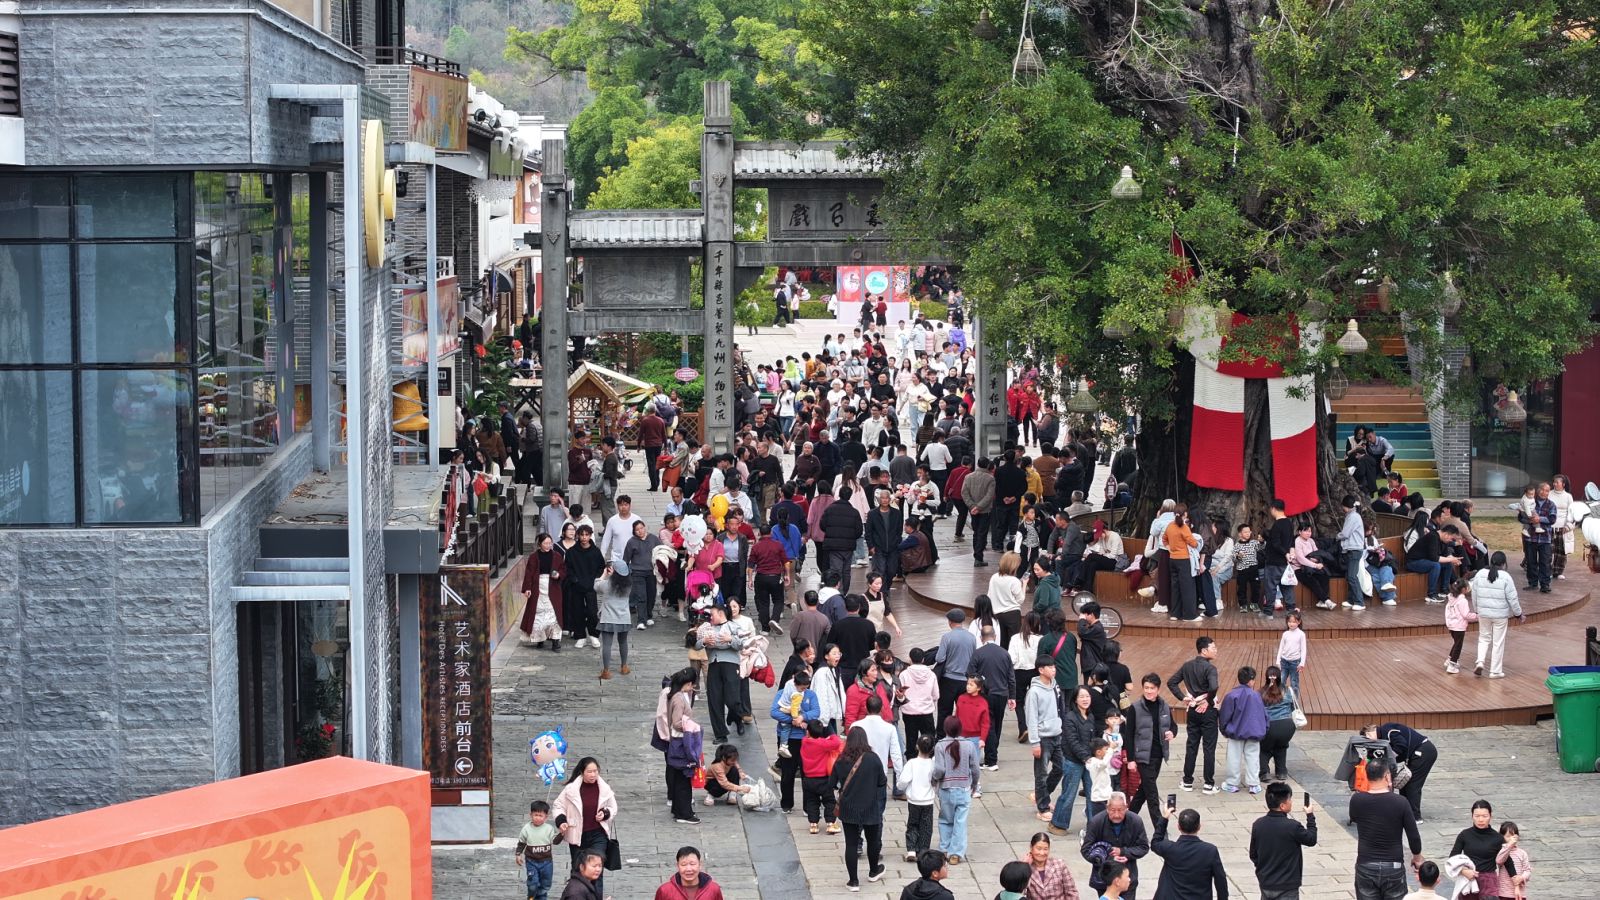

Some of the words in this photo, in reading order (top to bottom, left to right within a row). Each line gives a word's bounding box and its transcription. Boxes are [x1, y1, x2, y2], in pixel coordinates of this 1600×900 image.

[438, 621, 446, 642] Hotel
[438, 644, 446, 660] Des
[454, 622, 471, 752] 艺术家酒店前台
